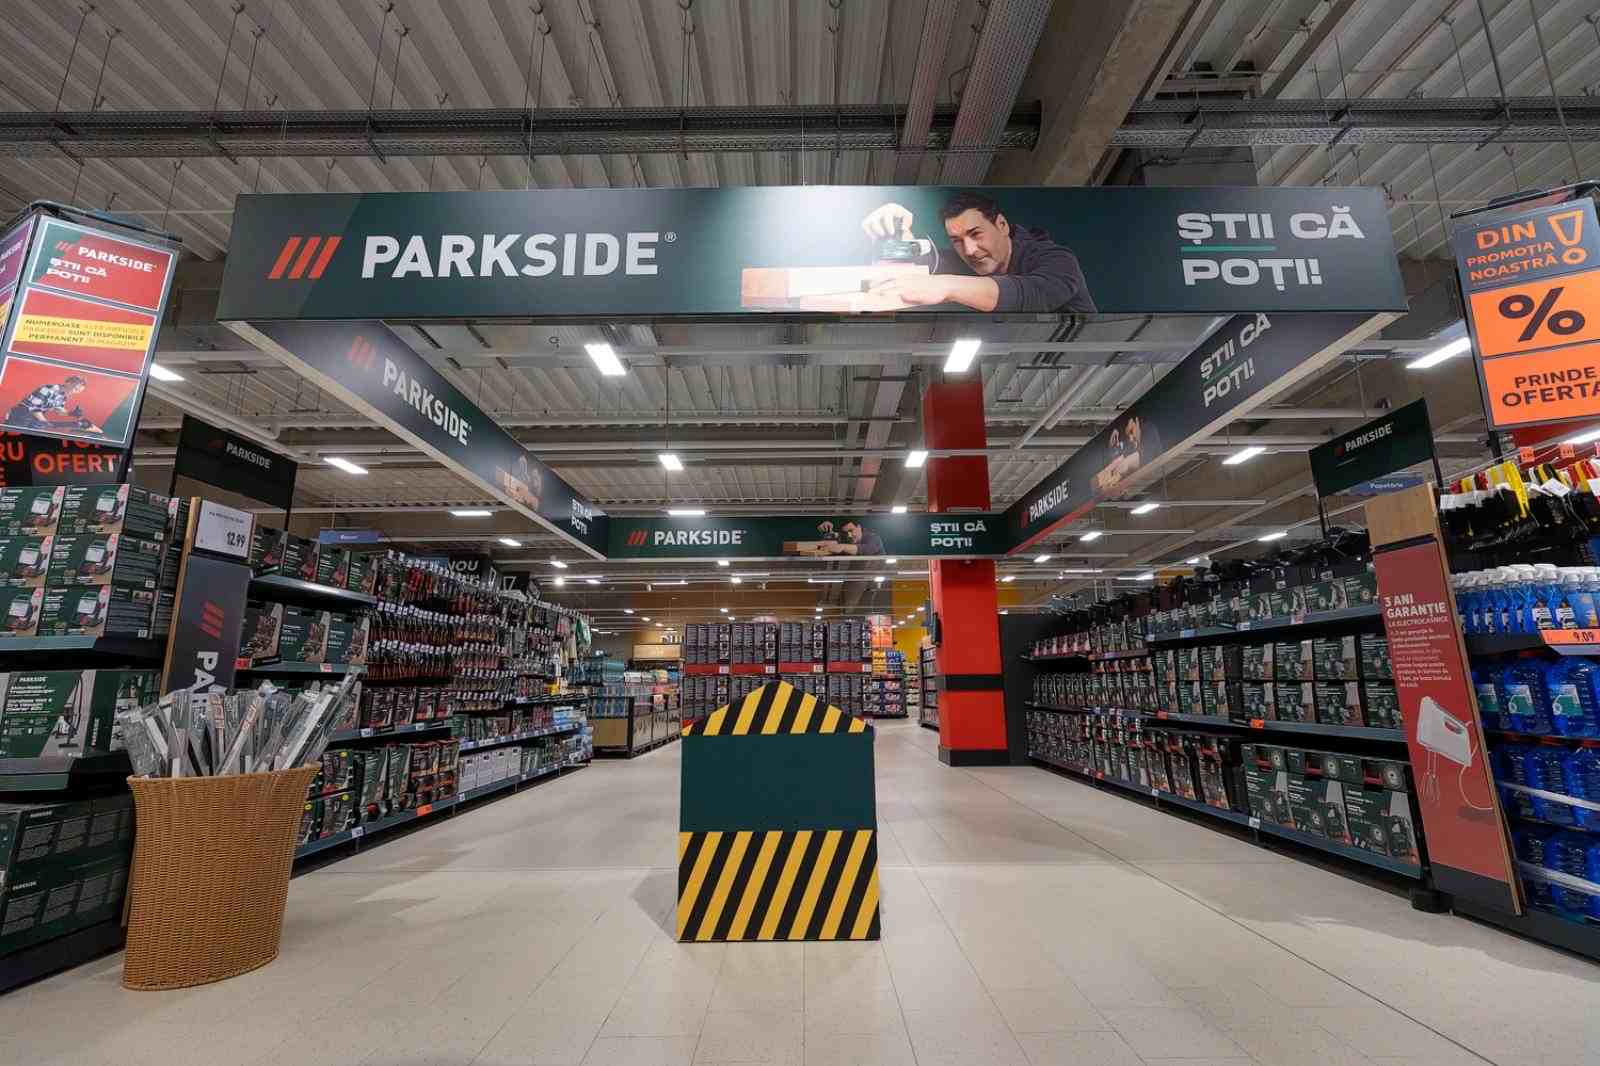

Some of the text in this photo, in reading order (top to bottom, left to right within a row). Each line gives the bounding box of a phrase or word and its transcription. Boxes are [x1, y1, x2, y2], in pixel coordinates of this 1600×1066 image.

[1177, 206, 1367, 245] ȘTII CĂ
[1475, 220, 1537, 251] DIN
[1182, 258, 1323, 292] POȚI!
[1514, 366, 1597, 389] PRINDE
[381, 357, 470, 447] PARKSIDE
[1344, 423, 1393, 452] PARKSIDE
[33, 452, 121, 474] OFERT
[225, 442, 272, 470] PARKSIDE
[1029, 479, 1070, 523] PARKSIDE
[653, 529, 743, 546] PARKSIDE
[964, 520, 988, 532] CĂ
[226, 531, 247, 549] 12.99
[1383, 592, 1414, 608] 3 ANI
[1386, 601, 1448, 618] GARANȚIE
[1572, 631, 1595, 642] 9.09
